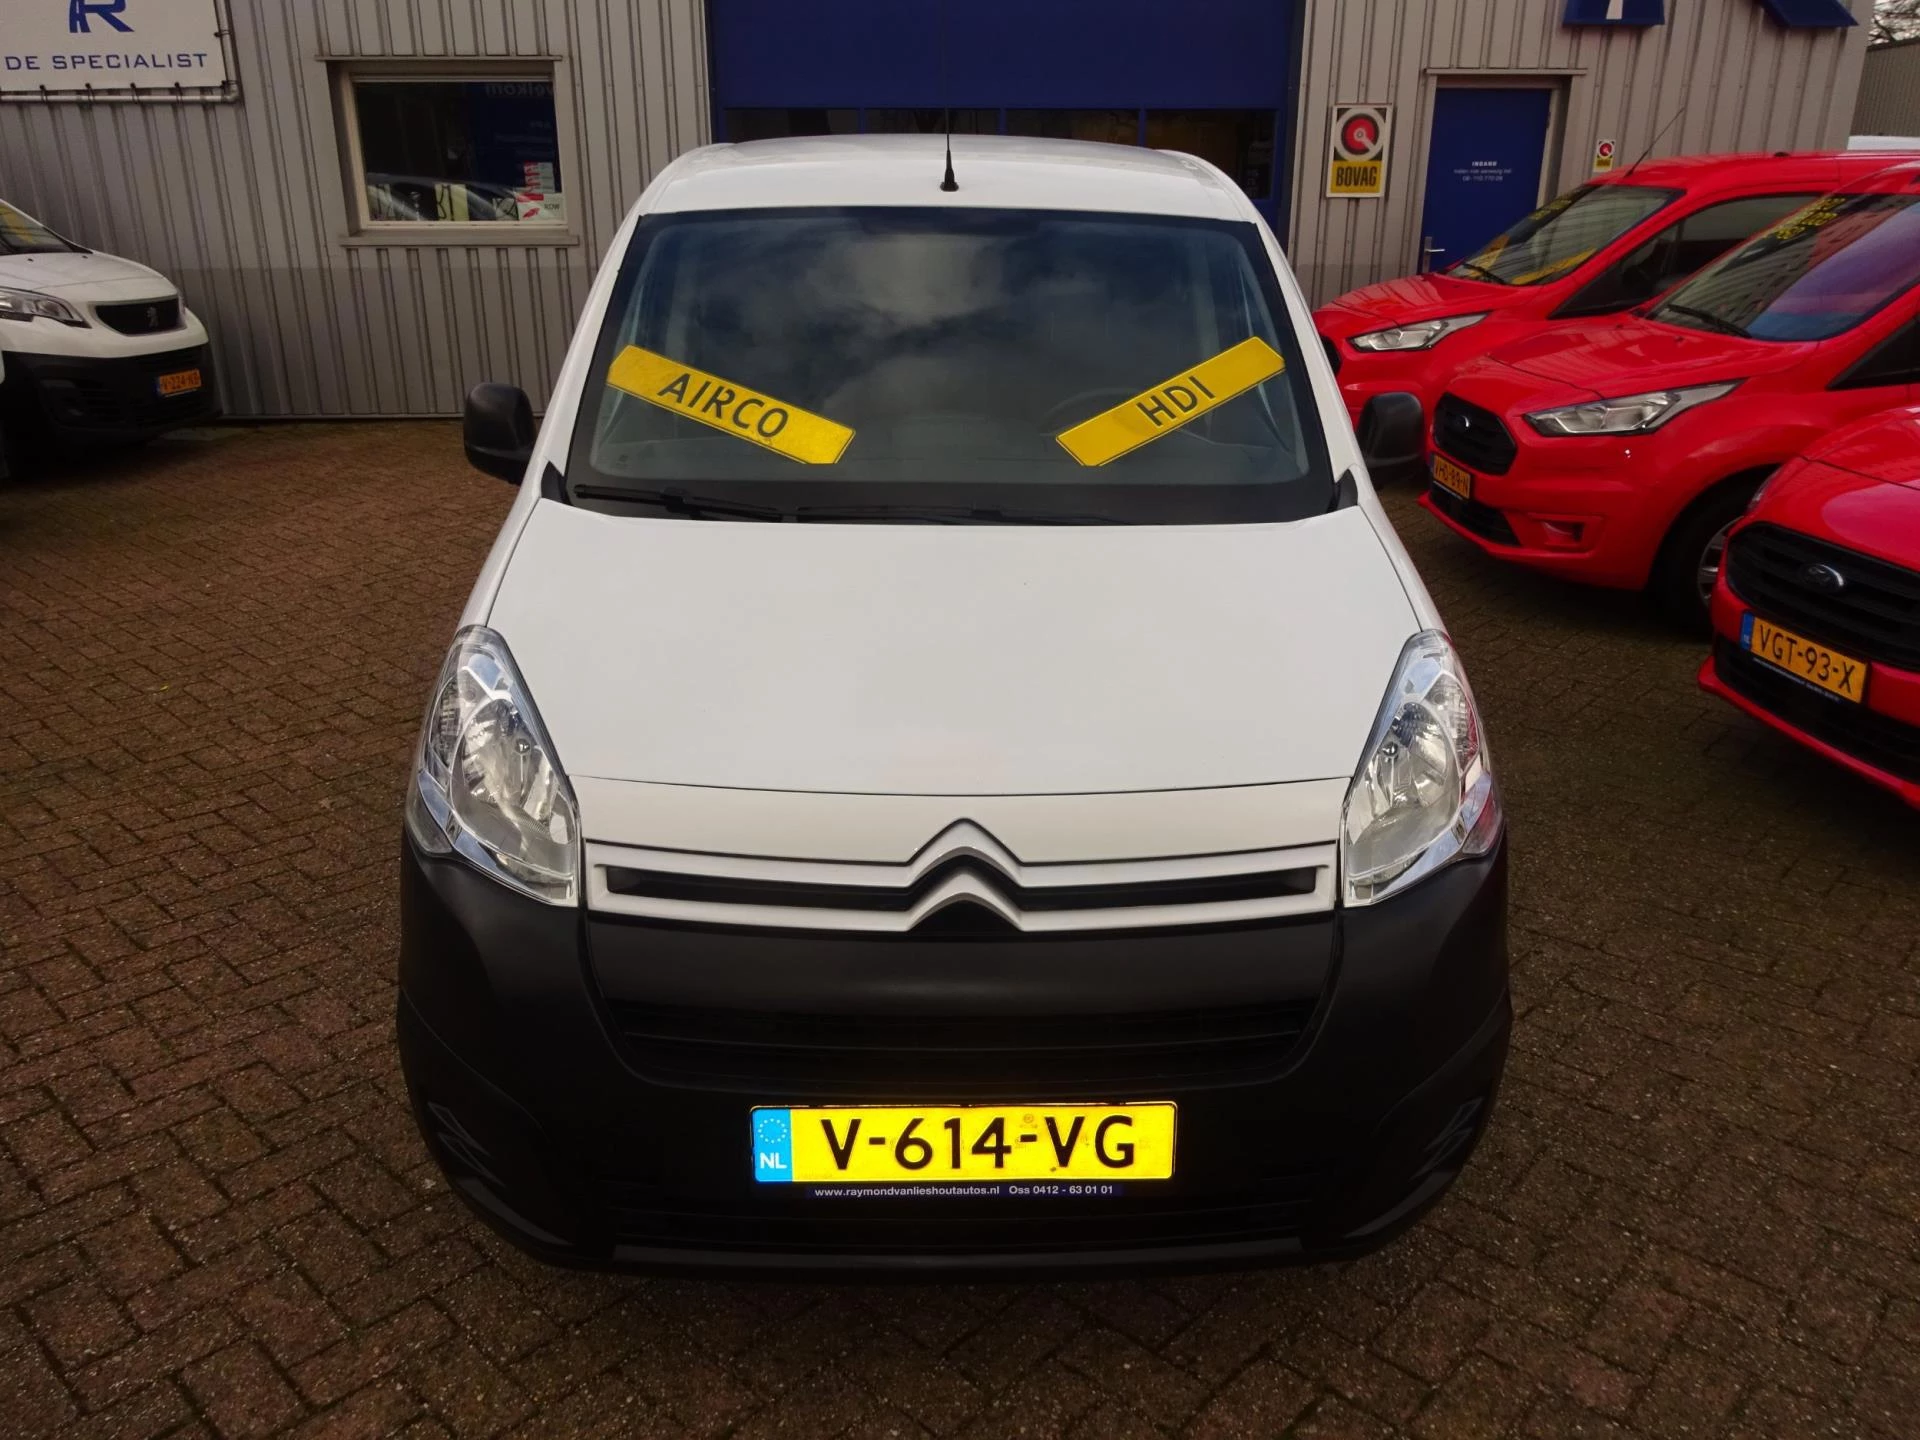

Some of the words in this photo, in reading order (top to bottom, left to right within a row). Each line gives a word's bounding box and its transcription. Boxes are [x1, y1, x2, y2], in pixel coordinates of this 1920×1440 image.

[5, 55, 40, 71] DE
[52, 53, 208, 70] SPECIALIST
[1335, 165, 1377, 187] BOVAG
[656, 372, 789, 438] AIRCO
[1135, 375, 1216, 427] HDI
[1759, 623, 1856, 694] VGT-93-X
[760, 1152, 787, 1169] NL
[820, 1114, 1135, 1171] V-614-VG
[814, 1185, 1000, 1198] www.raymondvanlieshoutautos.nl
[1008, 1185, 1030, 1195] Oss
[1033, 1185, 1059, 1195] 0412
[1069, 1185, 1083, 1195] 63
[1085, 1185, 1097, 1195] 01
[1100, 1185, 1113, 1195] 01
